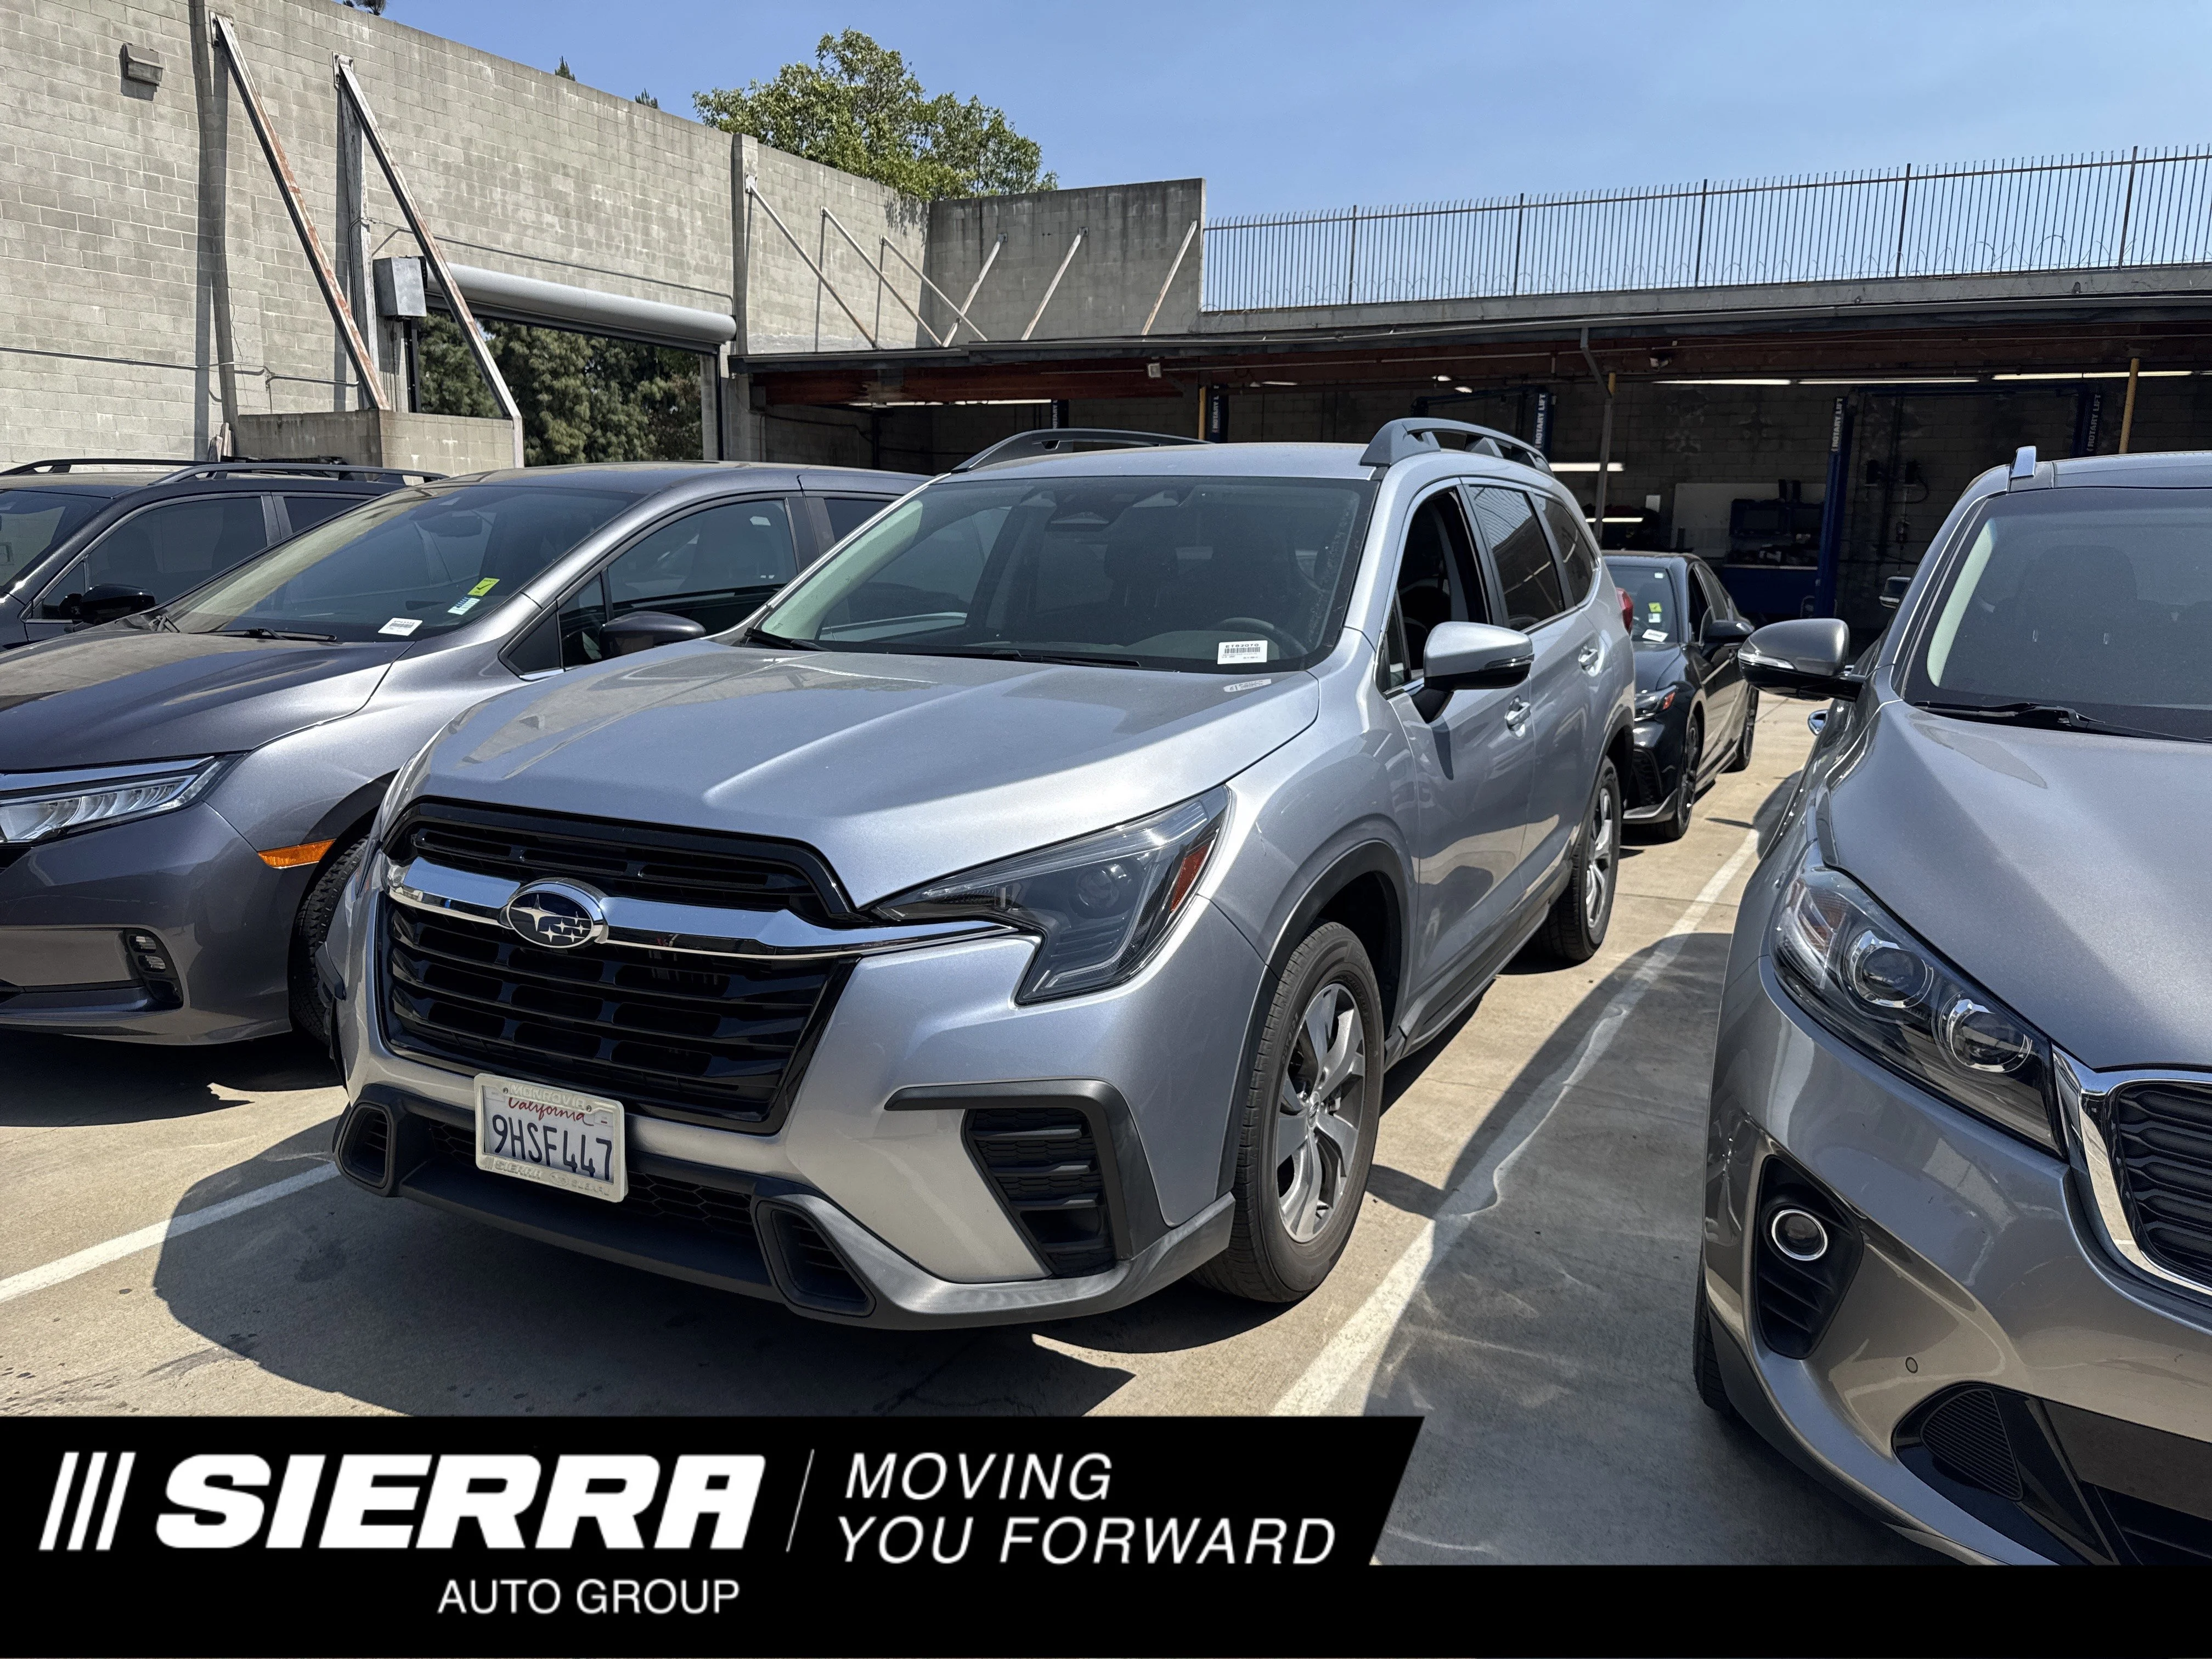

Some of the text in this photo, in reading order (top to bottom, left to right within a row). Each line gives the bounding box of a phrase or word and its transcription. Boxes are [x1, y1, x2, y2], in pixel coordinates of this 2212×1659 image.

[1534, 413, 1544, 444] ROTARY
[1832, 416, 1841, 447] ROTARY
[2087, 394, 2101, 447] ROTARY LIFT
[509, 1084, 586, 1109] MONROVIA
[492, 1114, 612, 1181] 9HSF447
[494, 1159, 542, 1180] SIERRA
